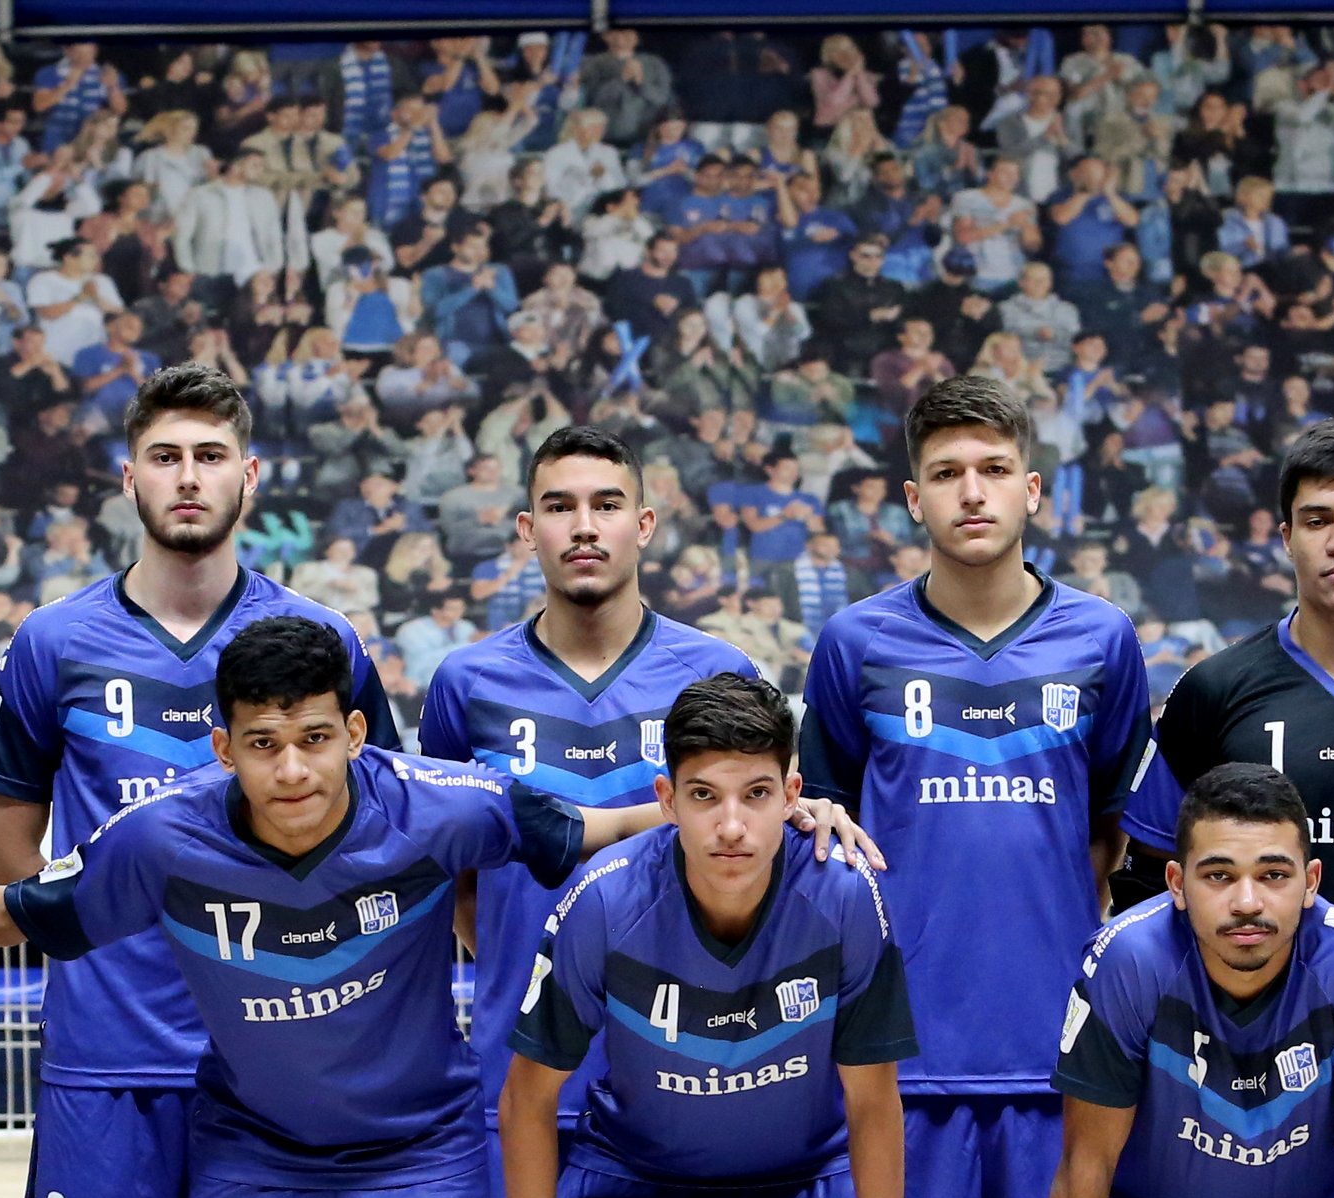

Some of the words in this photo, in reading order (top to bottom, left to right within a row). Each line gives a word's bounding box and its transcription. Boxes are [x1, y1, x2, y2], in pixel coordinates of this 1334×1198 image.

[104, 678, 134, 738] 9
[903, 679, 934, 738] 8
[509, 718, 536, 776] 3
[1263, 720, 1285, 774] 1
[918, 766, 1057, 805] minas
[558, 857, 629, 921] Risotolândia
[204, 902, 262, 961] 17
[241, 968, 387, 1022] minas
[649, 983, 680, 1043] 4
[655, 1055, 809, 1096] minas
[1187, 1030, 1210, 1089] 5
